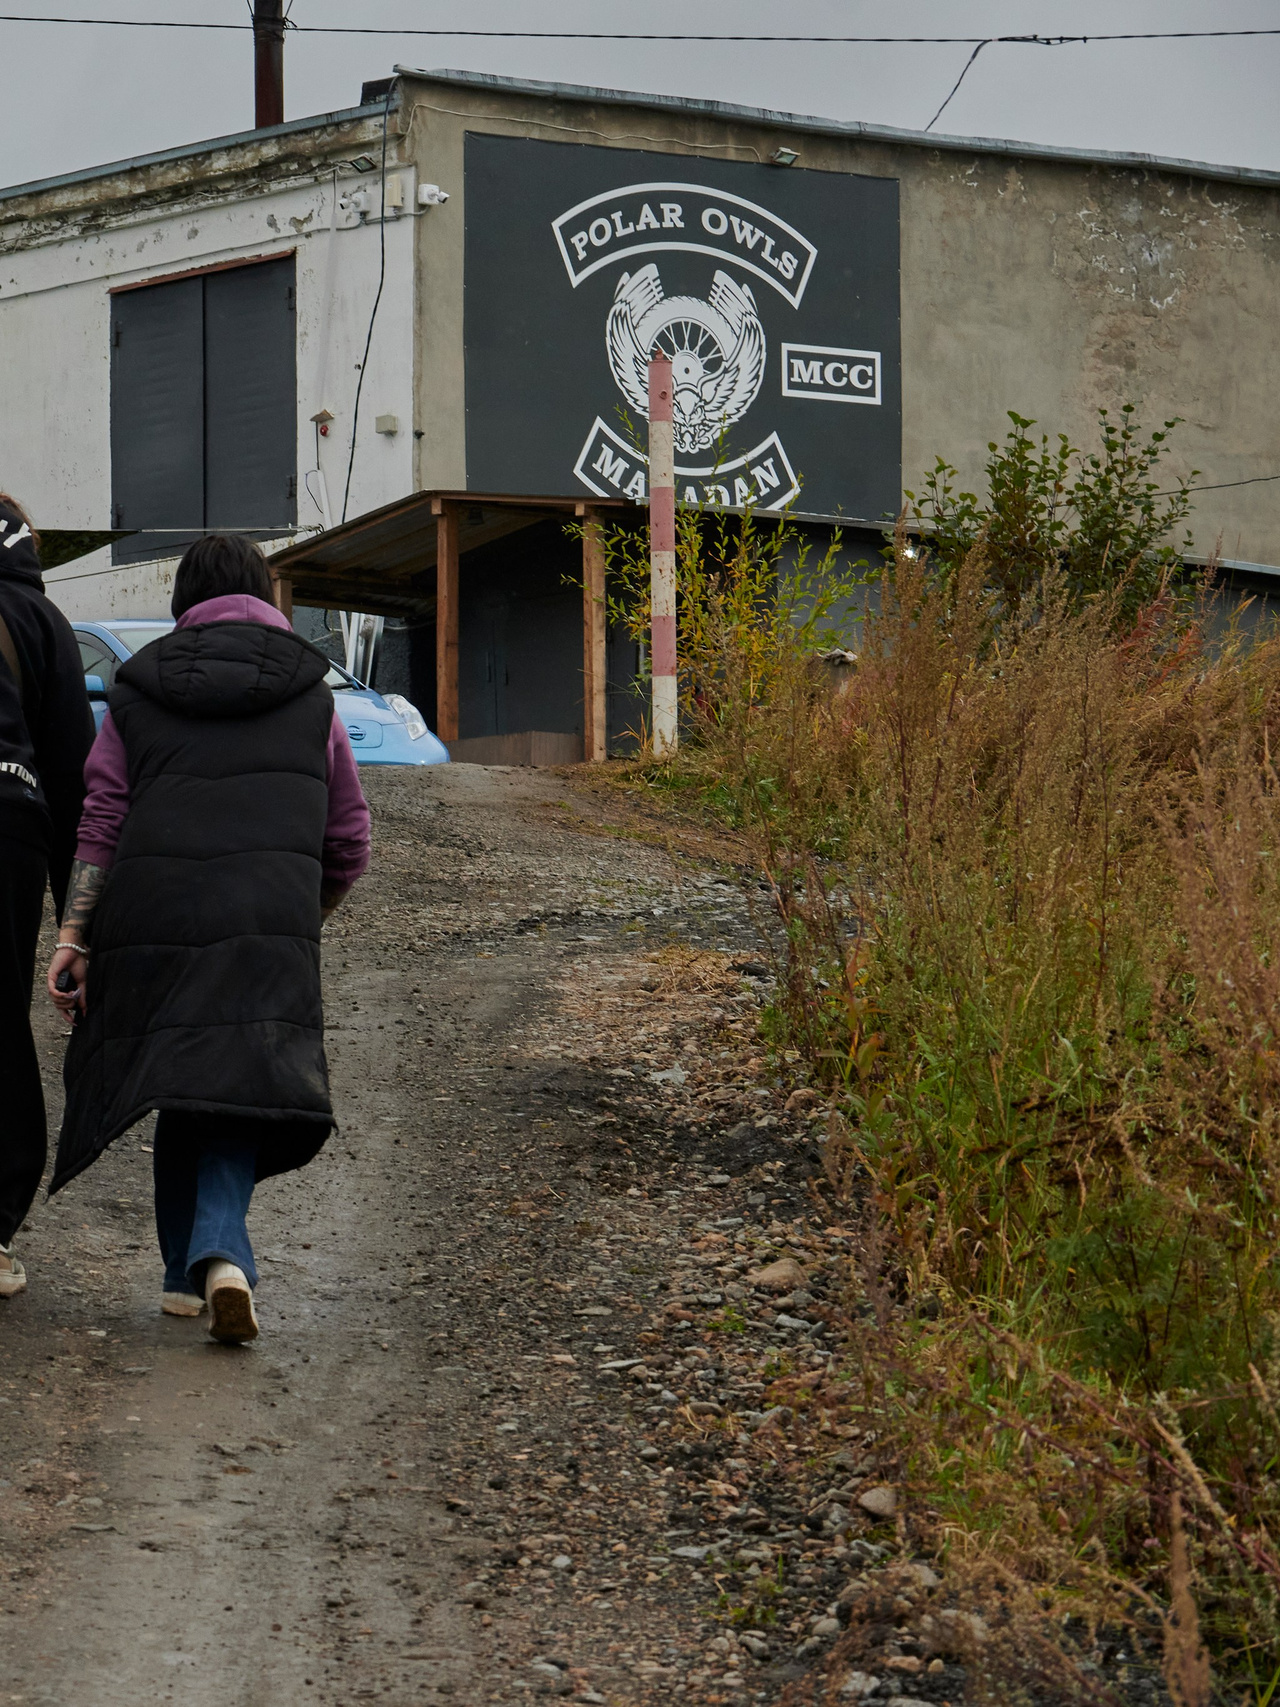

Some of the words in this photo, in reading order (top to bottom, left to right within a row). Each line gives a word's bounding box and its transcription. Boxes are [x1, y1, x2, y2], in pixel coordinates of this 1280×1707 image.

[570, 203, 685, 261] POLAR
[701, 208, 798, 280] OWLS
[789, 358, 874, 390] MCC
[592, 443, 780, 506] MAADAN
